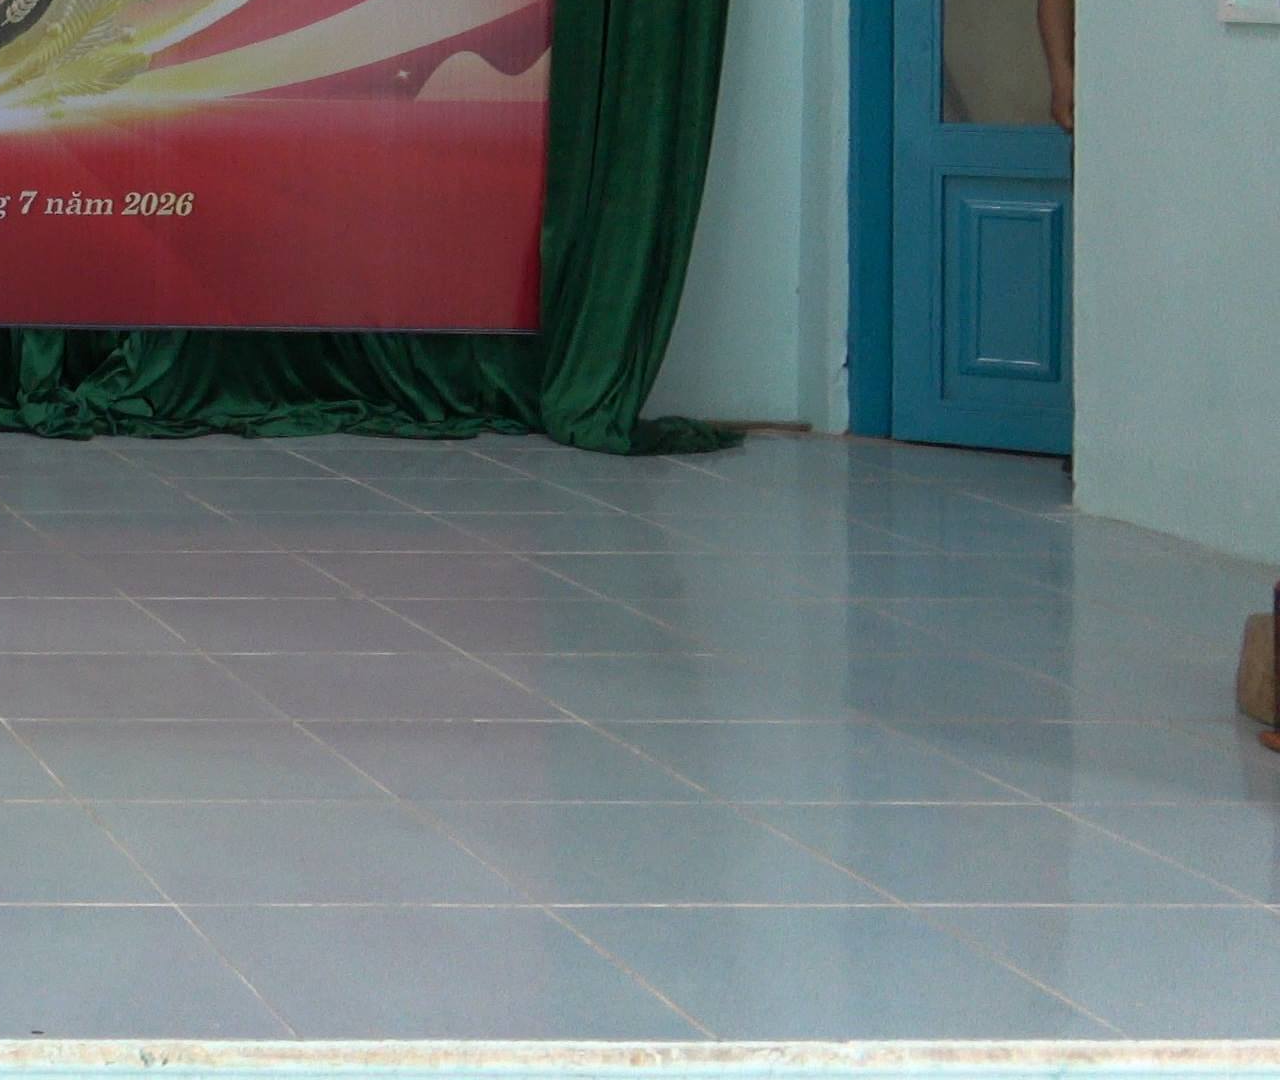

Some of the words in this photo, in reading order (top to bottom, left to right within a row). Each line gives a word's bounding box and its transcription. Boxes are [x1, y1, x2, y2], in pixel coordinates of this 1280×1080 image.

[18, 190, 38, 215] 7
[44, 191, 113, 217] năm
[121, 191, 195, 217] 2026
